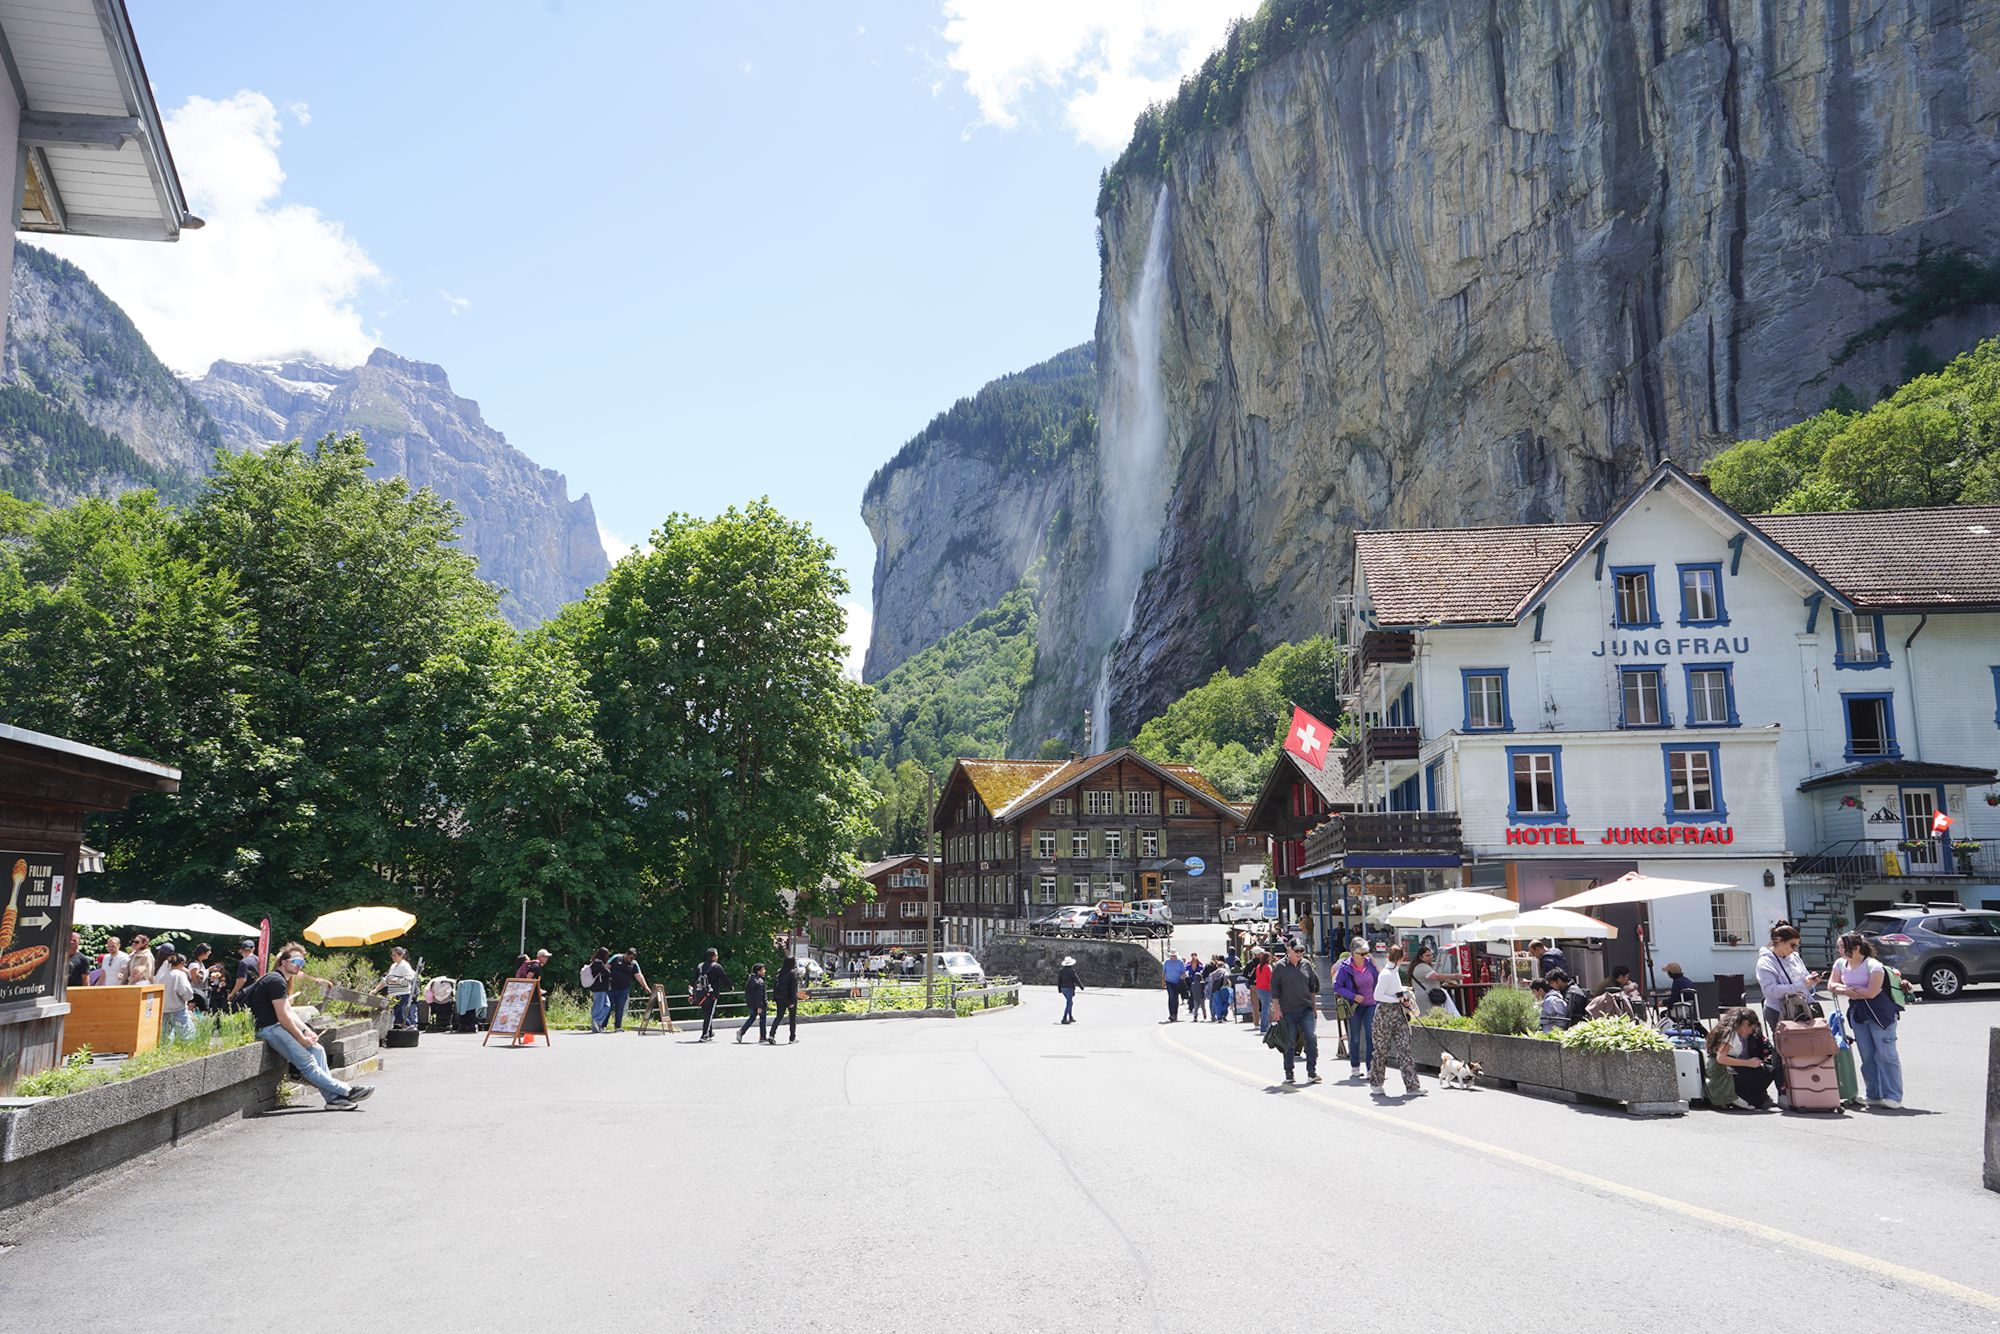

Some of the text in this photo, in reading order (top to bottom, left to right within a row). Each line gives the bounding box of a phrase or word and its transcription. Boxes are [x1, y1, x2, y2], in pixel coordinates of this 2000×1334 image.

[1592, 637, 1749, 657] JUNGFRAU
[1506, 827, 1734, 845] HOTEL JUNGFRAU
[28, 865, 52, 878] FOLLOW
[33, 880, 45, 892] THE
[25, 894, 49, 907] CRUNCH
[1266, 891, 1274, 906] P
[14, 983, 46, 996] Corndogs
